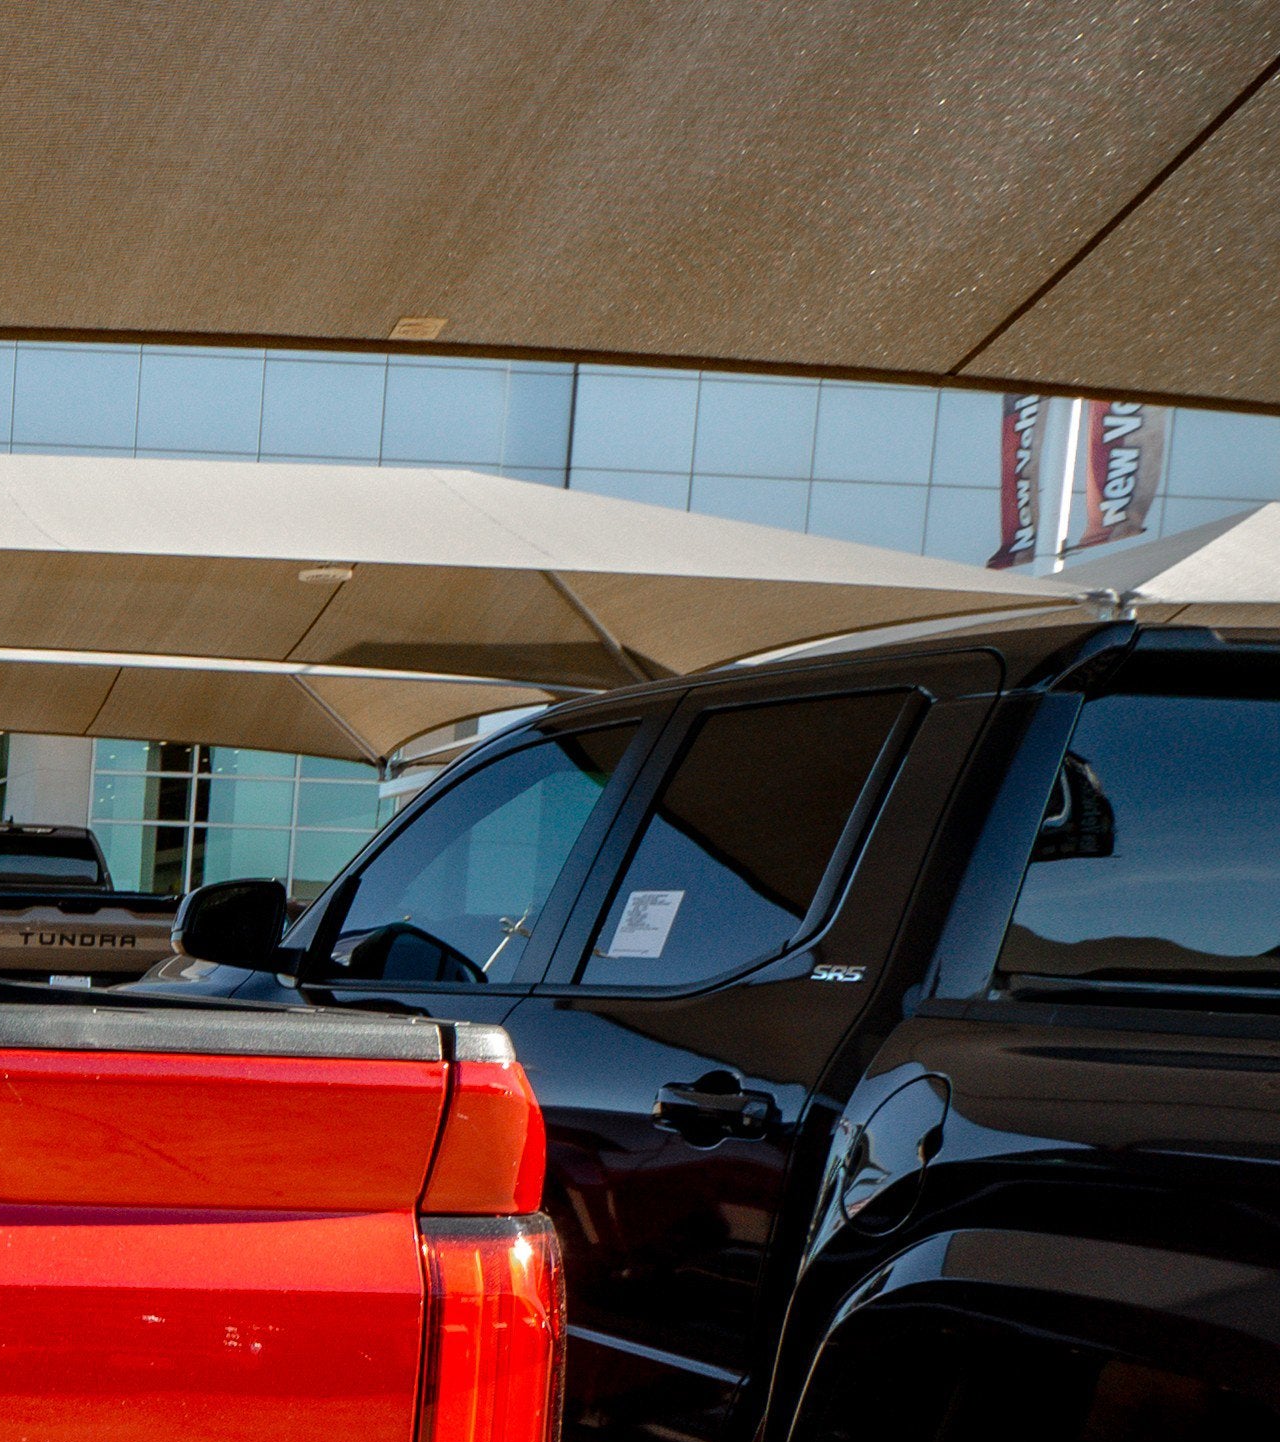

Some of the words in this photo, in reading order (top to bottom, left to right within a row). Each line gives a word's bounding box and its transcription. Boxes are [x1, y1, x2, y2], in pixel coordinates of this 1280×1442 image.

[1099, 448, 1140, 527] New
[19, 931, 137, 948] TUNDRA
[810, 964, 867, 981] SR5
